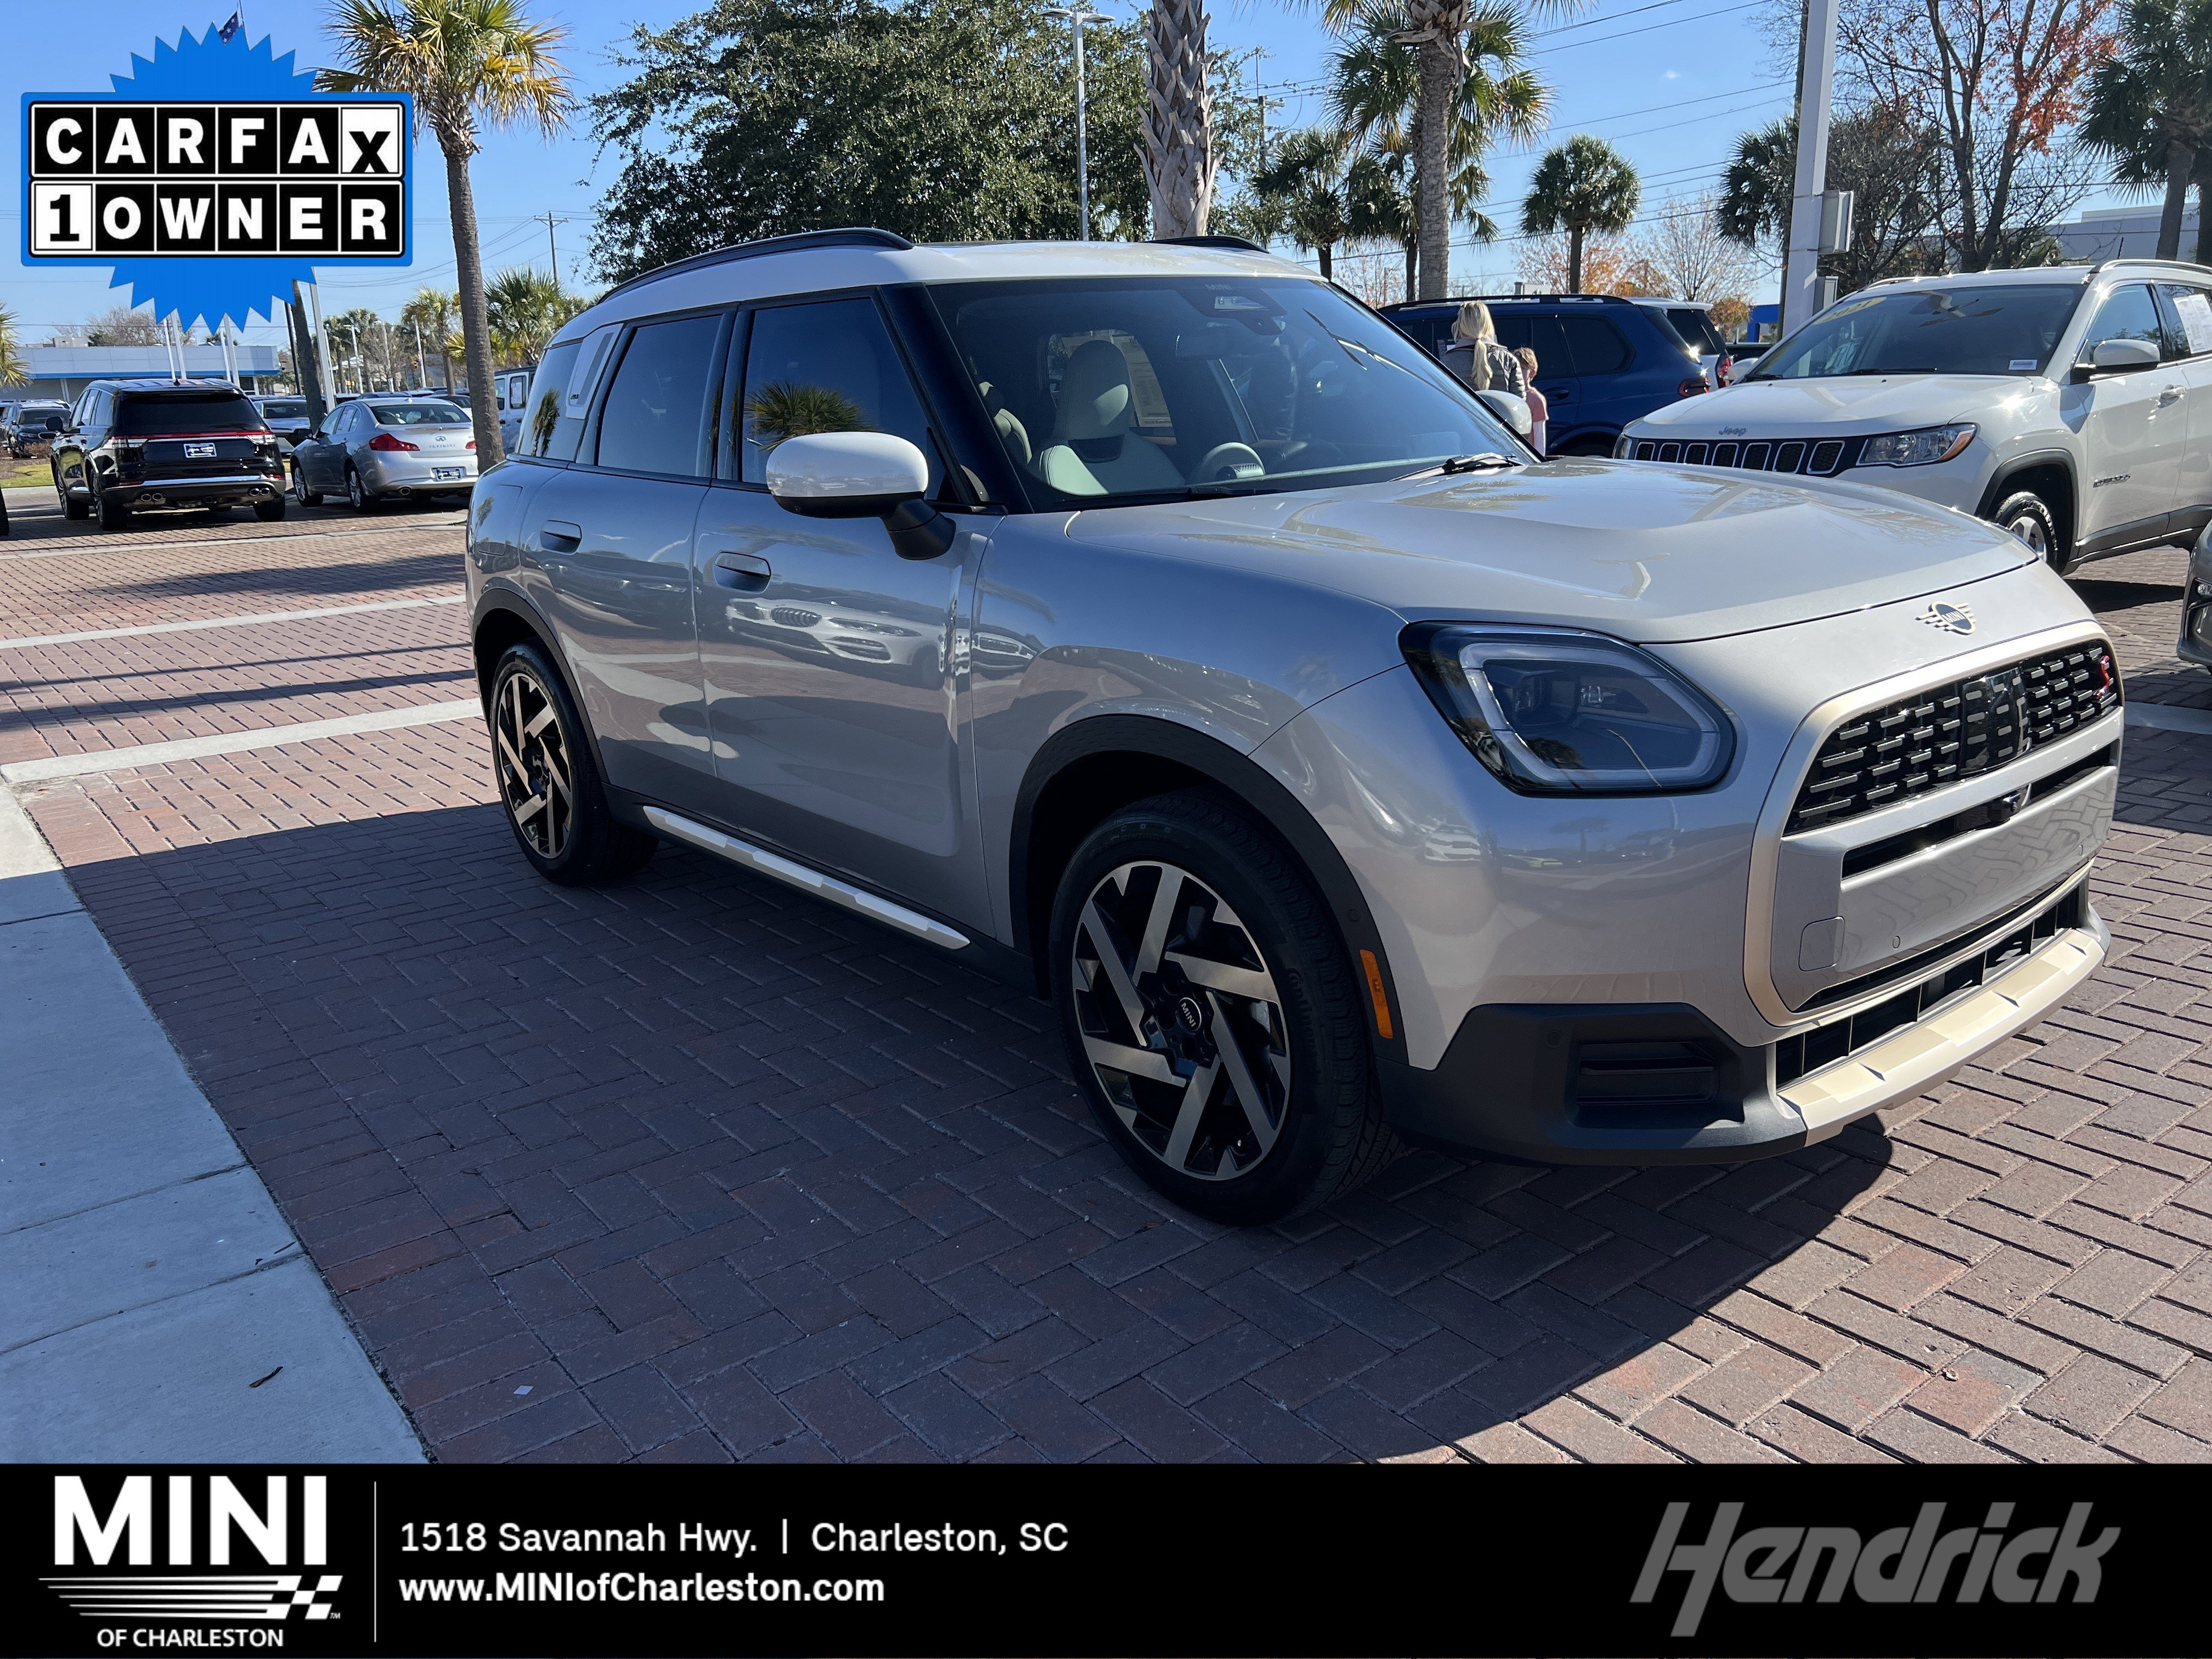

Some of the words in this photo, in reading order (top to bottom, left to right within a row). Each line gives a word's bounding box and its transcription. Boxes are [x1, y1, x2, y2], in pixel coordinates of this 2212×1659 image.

[1718, 426, 1747, 437] Jeep
[1940, 611, 1966, 623] MINI
[1181, 1002, 1196, 1027] MINI
